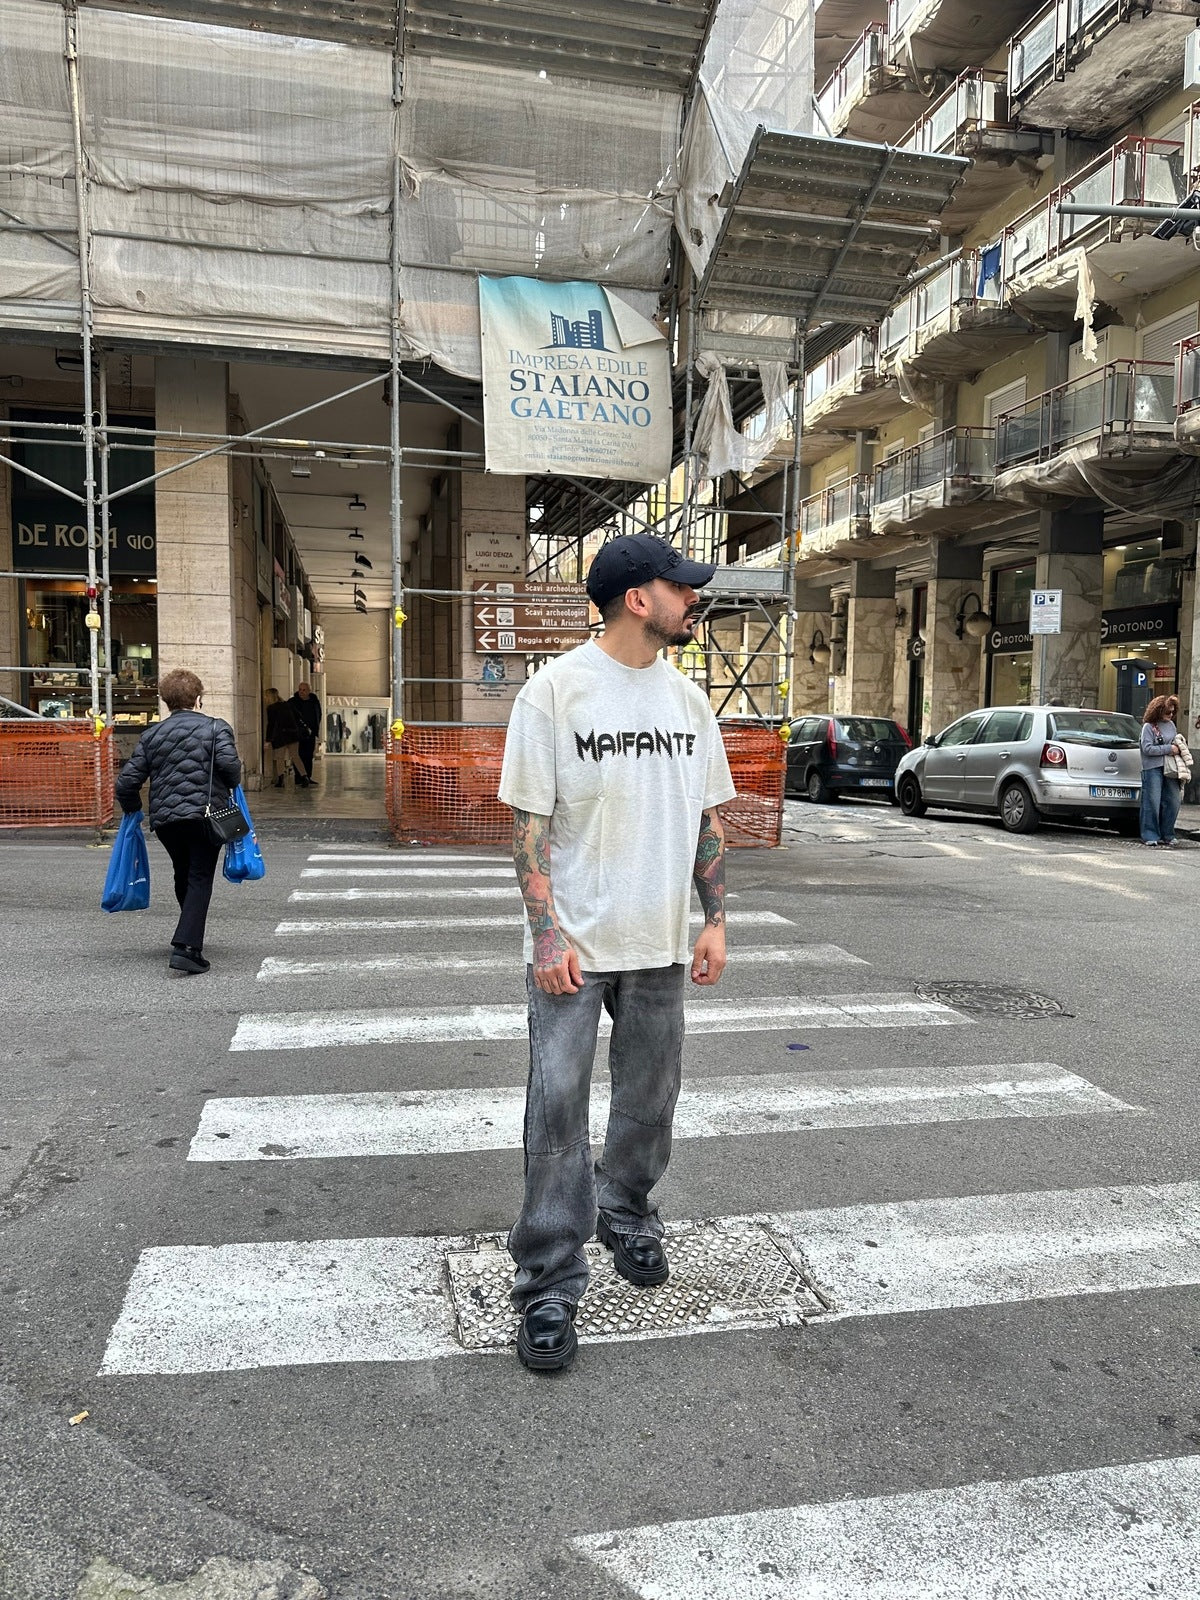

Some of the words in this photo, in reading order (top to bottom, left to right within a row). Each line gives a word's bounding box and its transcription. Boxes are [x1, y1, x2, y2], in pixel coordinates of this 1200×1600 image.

[509, 350, 592, 371] IMPRESA
[597, 356, 649, 377] EDILE
[510, 369, 650, 402] STAIANO
[510, 397, 651, 428] GAETANO
[18, 523, 48, 546] DE
[127, 535, 154, 550] GIO
[493, 551, 514, 559] DENZA
[525, 583, 543, 592] Scavi
[546, 584, 587, 594] archeologici
[525, 607, 543, 616] Scavi
[546, 608, 586, 618] archeologici
[541, 618, 558, 627] Villa
[561, 618, 586, 627] Arianna
[517, 636, 543, 645] Reggia
[545, 636, 552, 644] di
[1137, 672, 1146, 686] P
